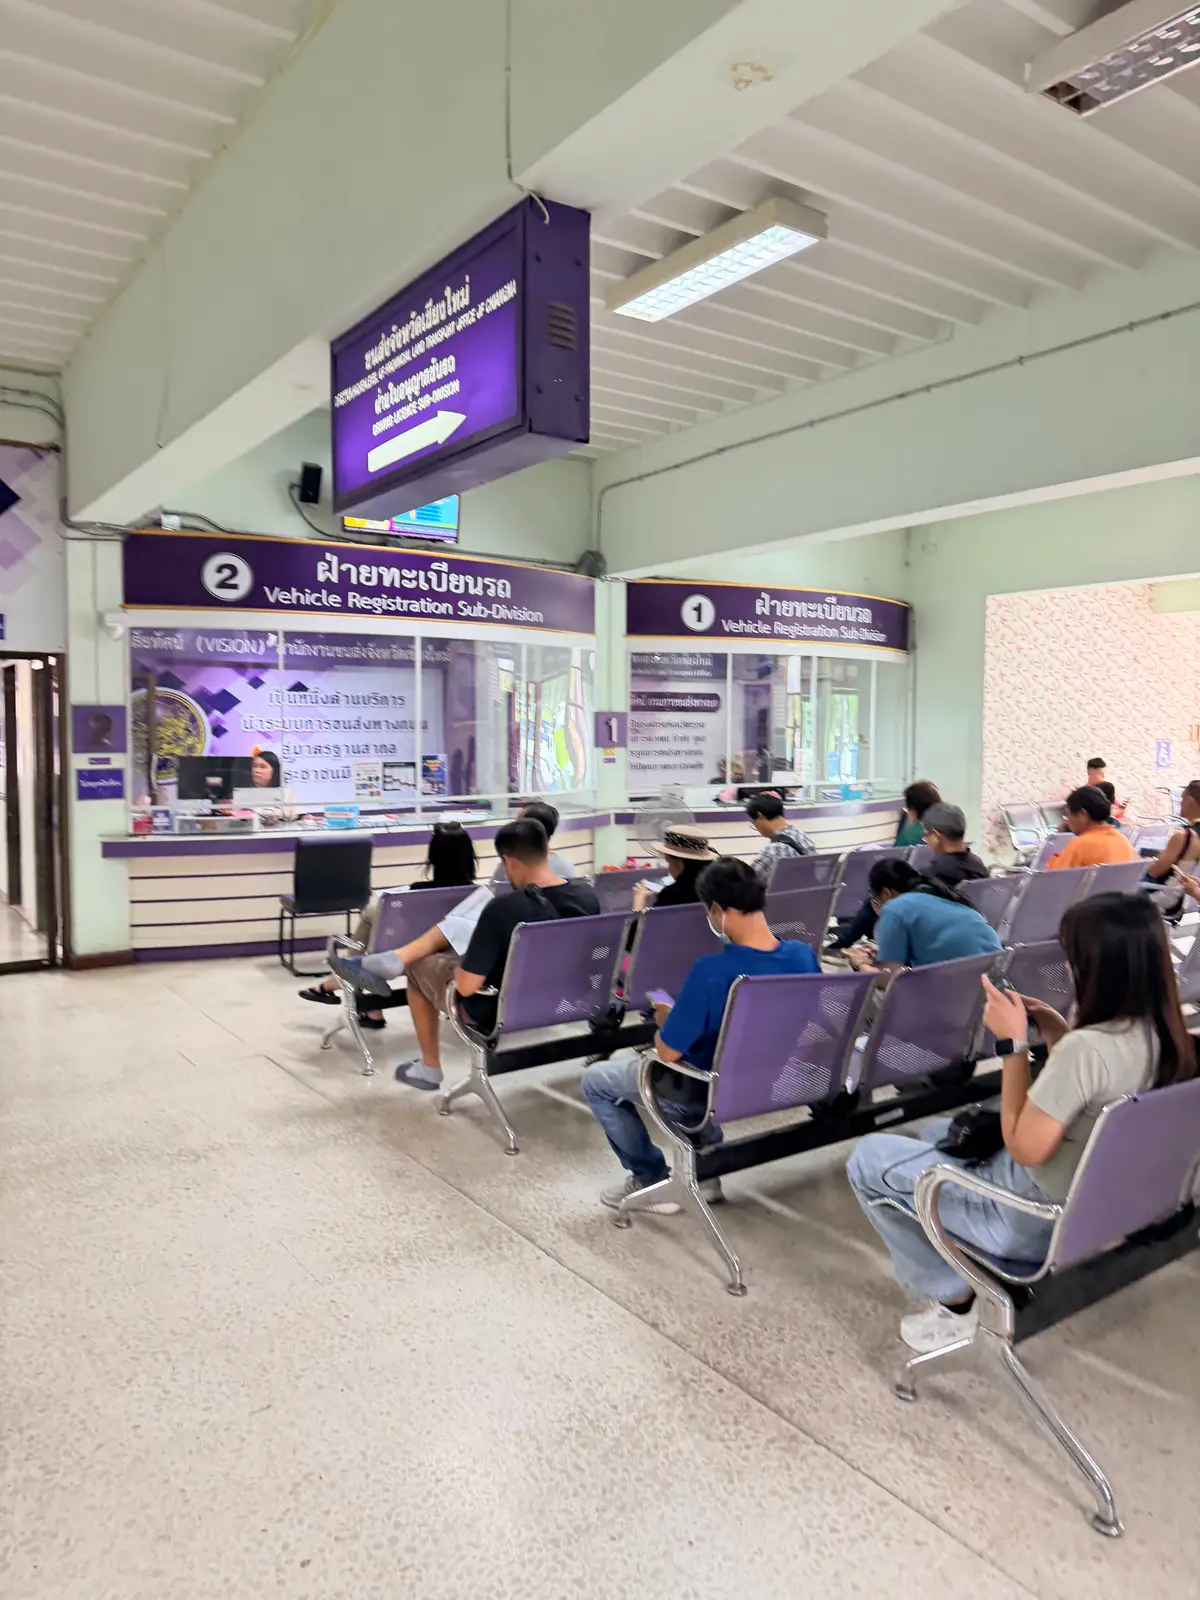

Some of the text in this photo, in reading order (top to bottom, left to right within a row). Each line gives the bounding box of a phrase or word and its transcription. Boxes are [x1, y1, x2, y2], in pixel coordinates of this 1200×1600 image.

[214, 564, 240, 590] 2
[316, 551, 512, 599] ฝ่ายทะเบียนรถ
[263, 586, 545, 623] Vehicle Registration Sub-Division
[691, 602, 702, 623] 1
[755, 591, 873, 625] ฝ่ายทะเบียนรถ
[721, 618, 889, 643] Vehicle Registration Sub-Division
[196, 634, 266, 656] (VISION)
